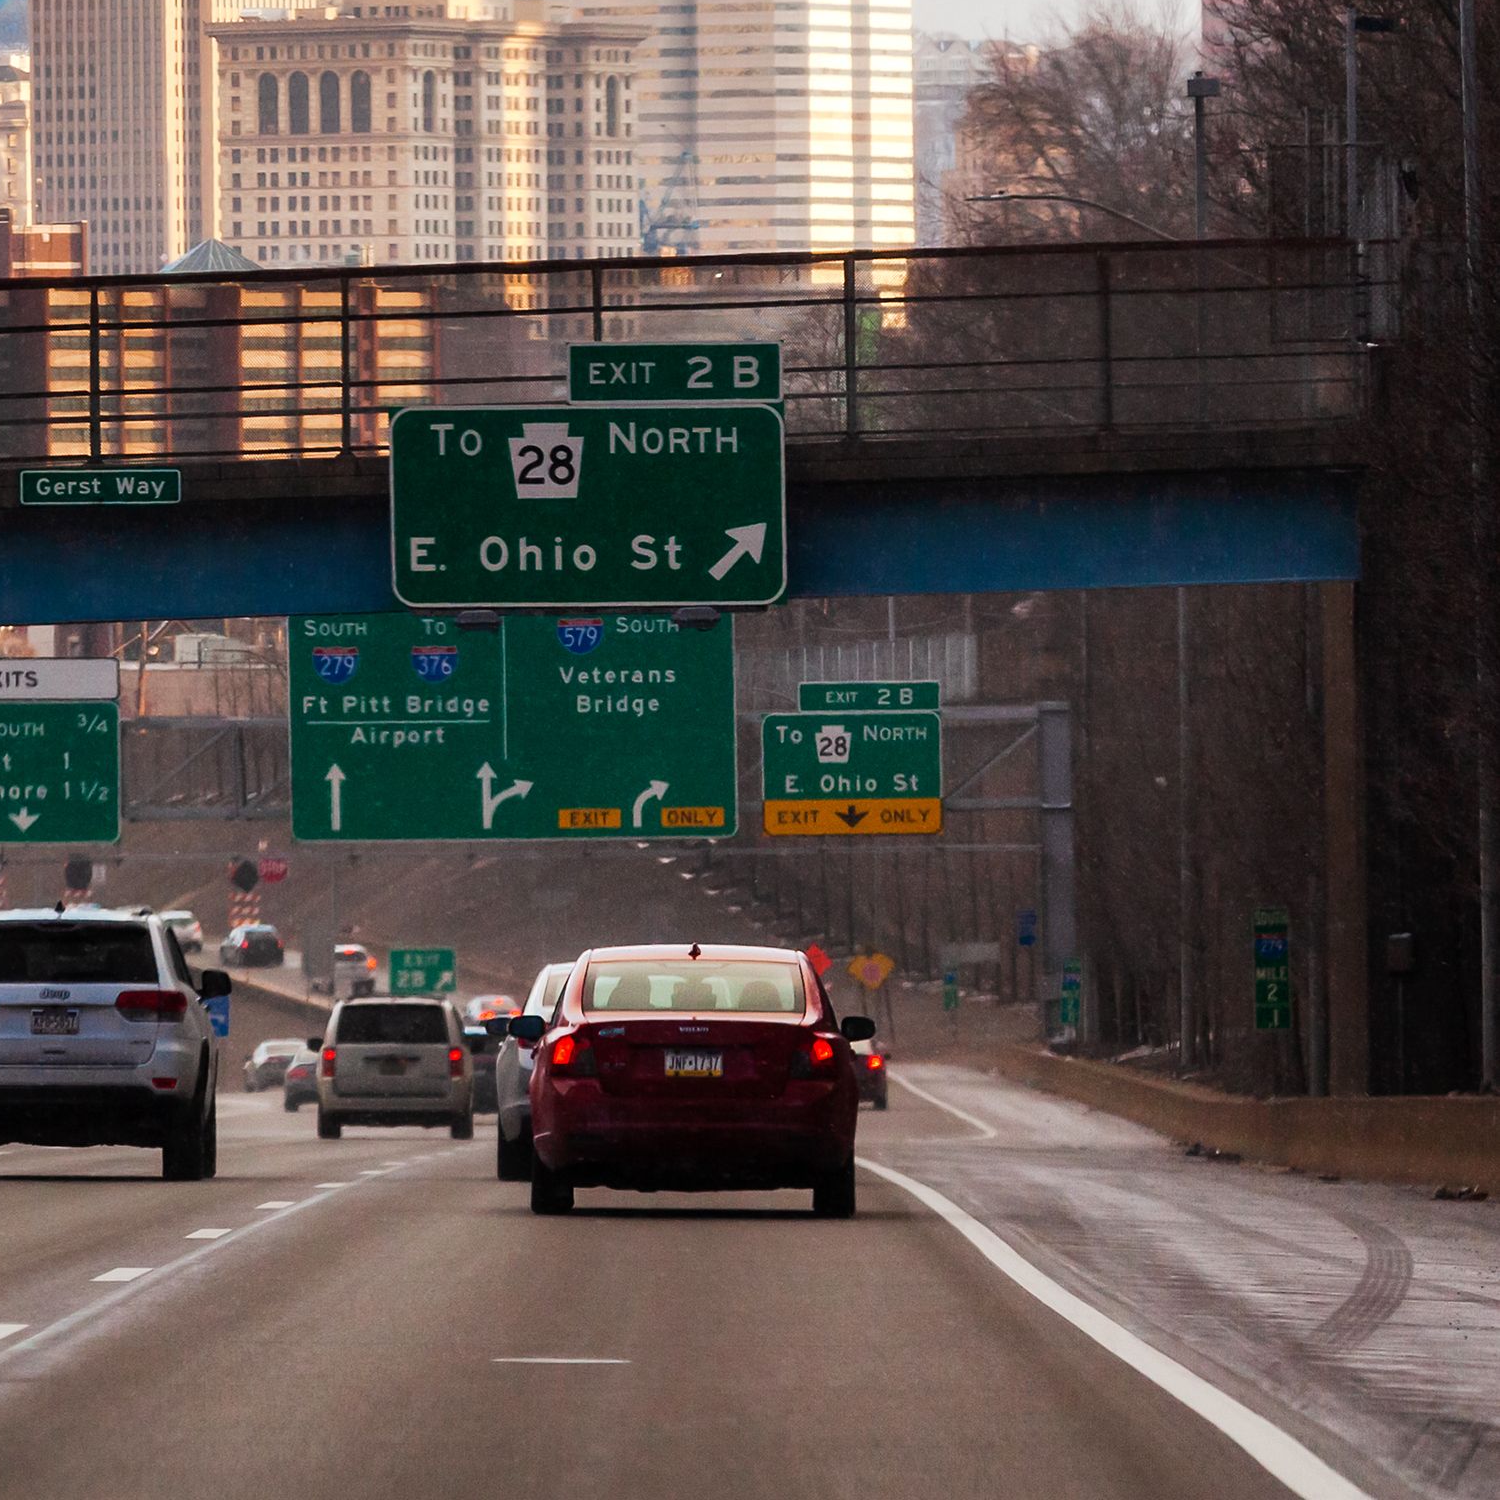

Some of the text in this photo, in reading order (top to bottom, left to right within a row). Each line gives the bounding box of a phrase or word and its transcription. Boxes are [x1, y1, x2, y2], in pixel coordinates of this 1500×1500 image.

[588, 362, 656, 385] EXIT
[517, 444, 576, 487] 28
[608, 421, 739, 455] NORTH
[36, 476, 166, 499] Gerst Way
[410, 534, 683, 573] E. Ohio St
[304, 618, 367, 637] SOUTH
[562, 617, 681, 649] 579 SOUTH
[319, 653, 453, 677] 279 376
[558, 665, 676, 685] Veterans
[302, 695, 490, 719] Ft Pitt Bridge
[576, 693, 660, 718] Bridge
[825, 690, 858, 703] EXIT
[350, 724, 446, 748] Airport
[819, 733, 849, 756] 28
[863, 725, 928, 743] NORTH
[820, 773, 878, 793] Ohio
[893, 773, 919, 793] St
[571, 808, 717, 826] EXIT ONLY
[777, 808, 931, 826] EXIT ONLY
[404, 953, 440, 967] EXIT
[40, 987, 70, 1001] Jeep
[1267, 983, 1278, 1001] 2
